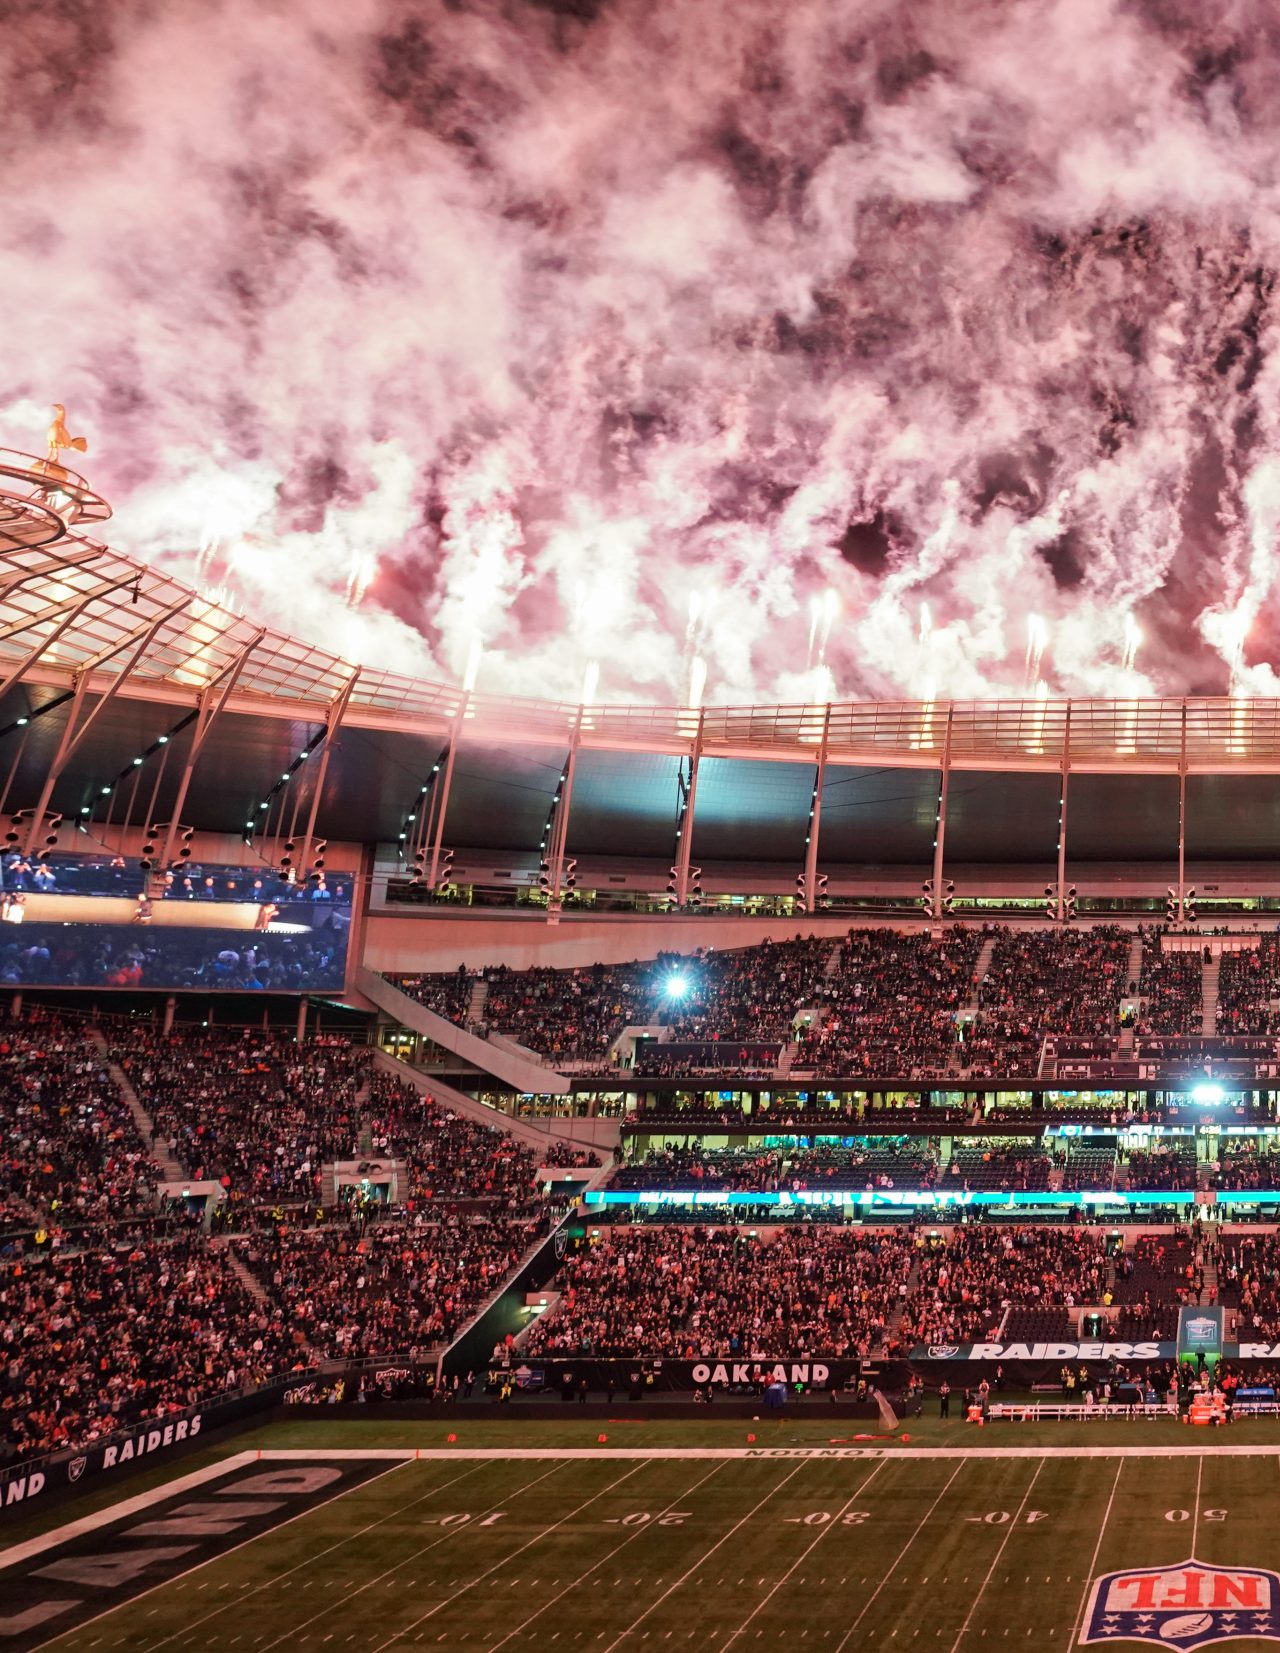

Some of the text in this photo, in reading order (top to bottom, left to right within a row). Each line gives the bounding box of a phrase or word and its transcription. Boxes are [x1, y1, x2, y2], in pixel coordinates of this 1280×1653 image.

[968, 1343, 1161, 1360] RAIDERS
[692, 1364, 829, 1383] OAKLAND
[0, 1414, 202, 1508] ND RAIDERS
[1117, 1572, 1264, 1609] NFL
